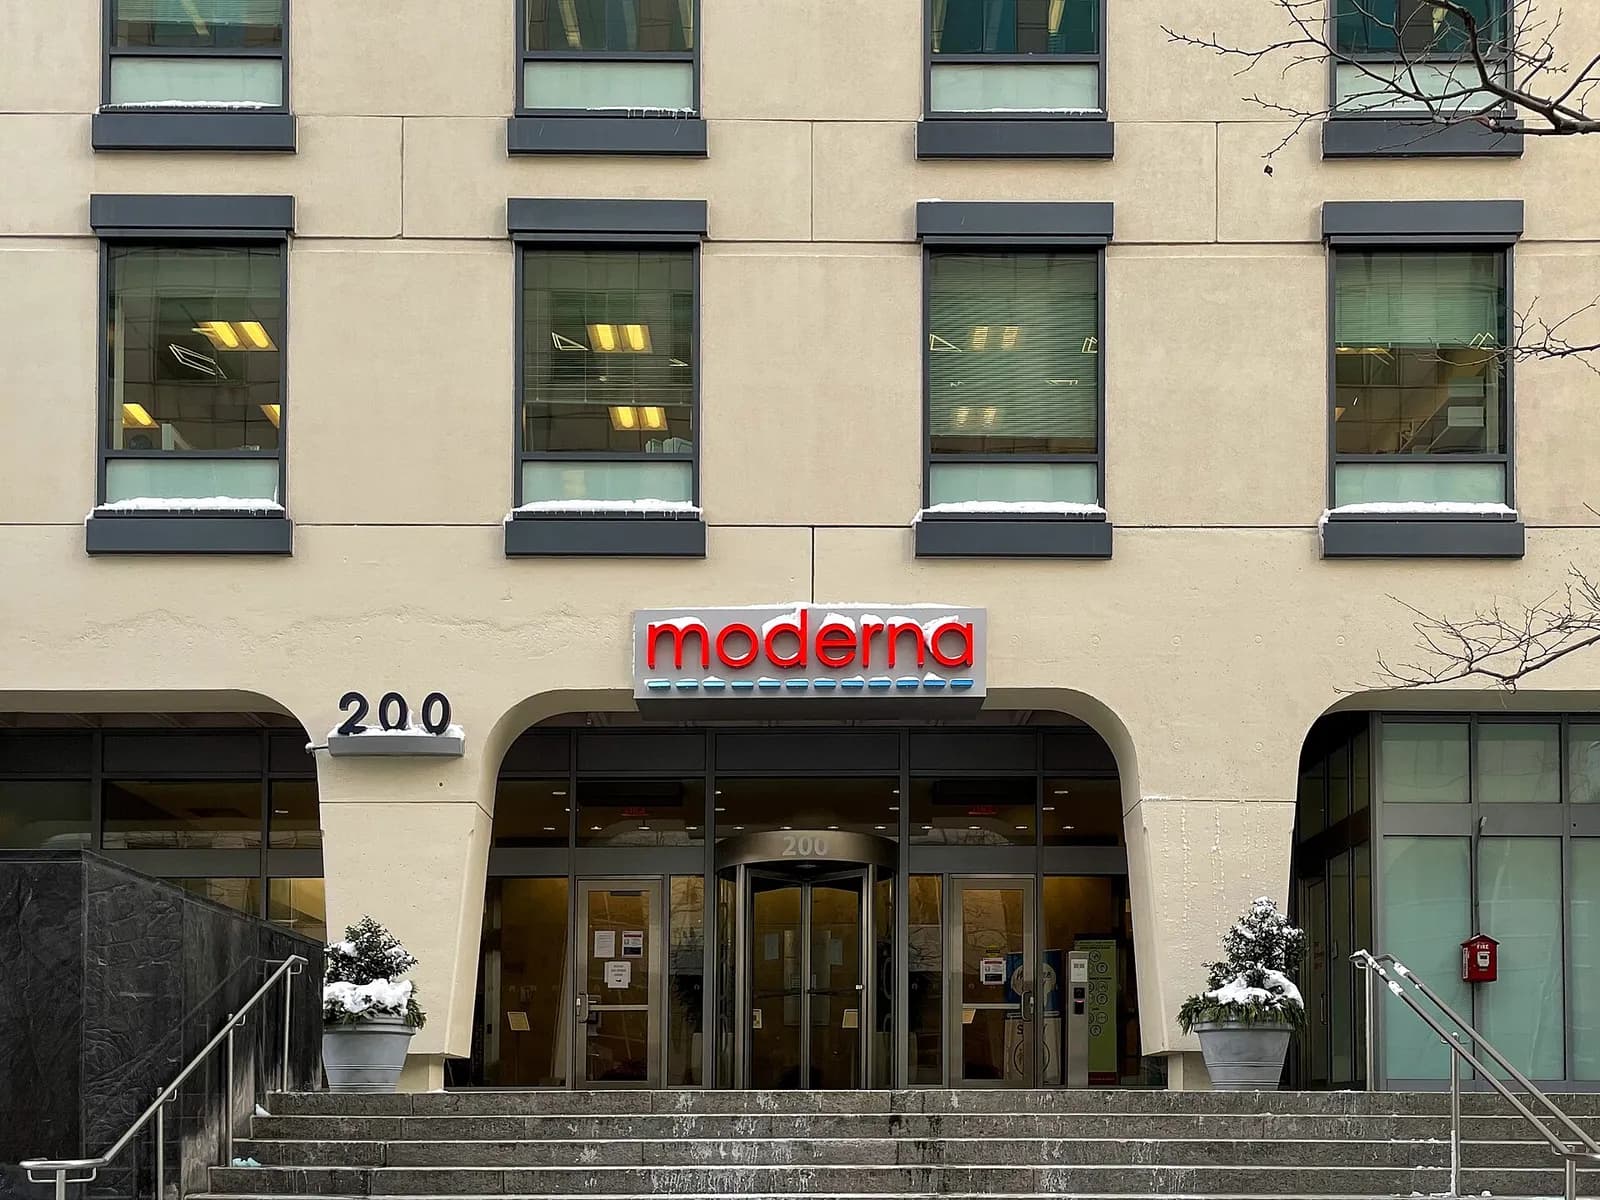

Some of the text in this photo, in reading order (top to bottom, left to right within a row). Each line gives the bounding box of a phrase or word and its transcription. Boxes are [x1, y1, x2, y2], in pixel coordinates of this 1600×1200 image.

[647, 608, 973, 669] moderna
[338, 691, 452, 736] 200
[782, 836, 828, 857] 200
